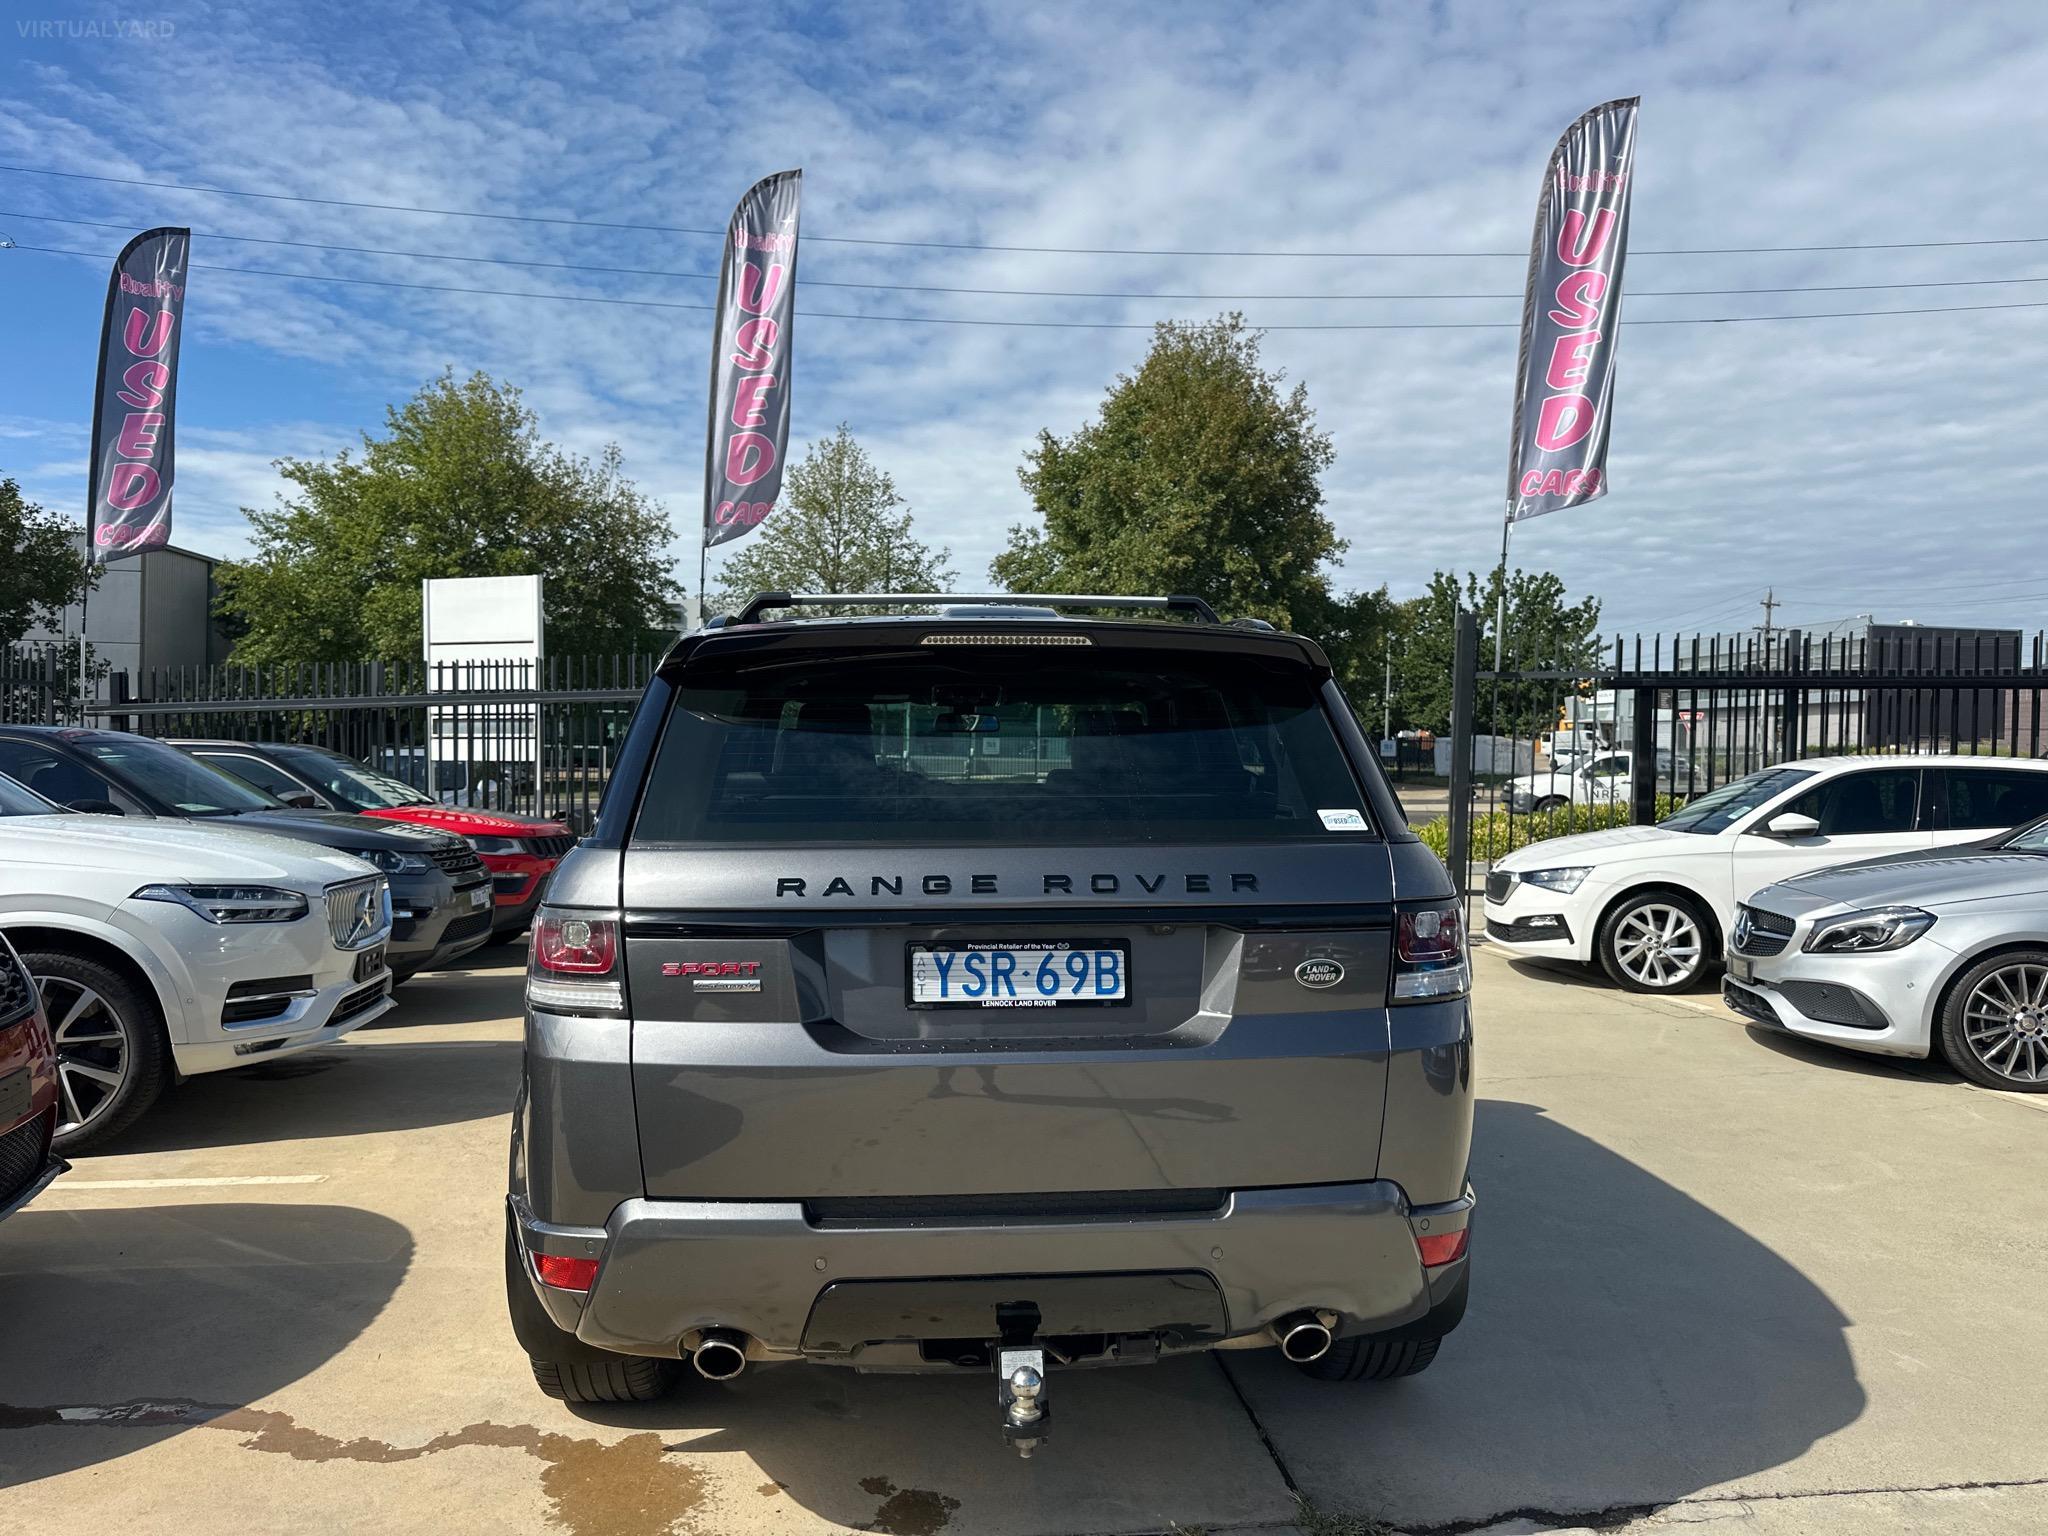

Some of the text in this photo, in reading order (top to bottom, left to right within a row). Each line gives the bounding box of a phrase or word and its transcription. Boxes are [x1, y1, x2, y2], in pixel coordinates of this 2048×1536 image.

[120, 272, 184, 301] Quality
[1534, 208, 1616, 452] USED
[725, 262, 784, 486] USED
[107, 306, 176, 511] USED
[1520, 468, 1601, 497] CARS
[776, 873, 1260, 897] RANGE ROVER
[661, 961, 761, 976] SPORT
[917, 956, 926, 996] ACT
[1306, 965, 1330, 974] LAND
[1308, 972, 1337, 982] ROVER
